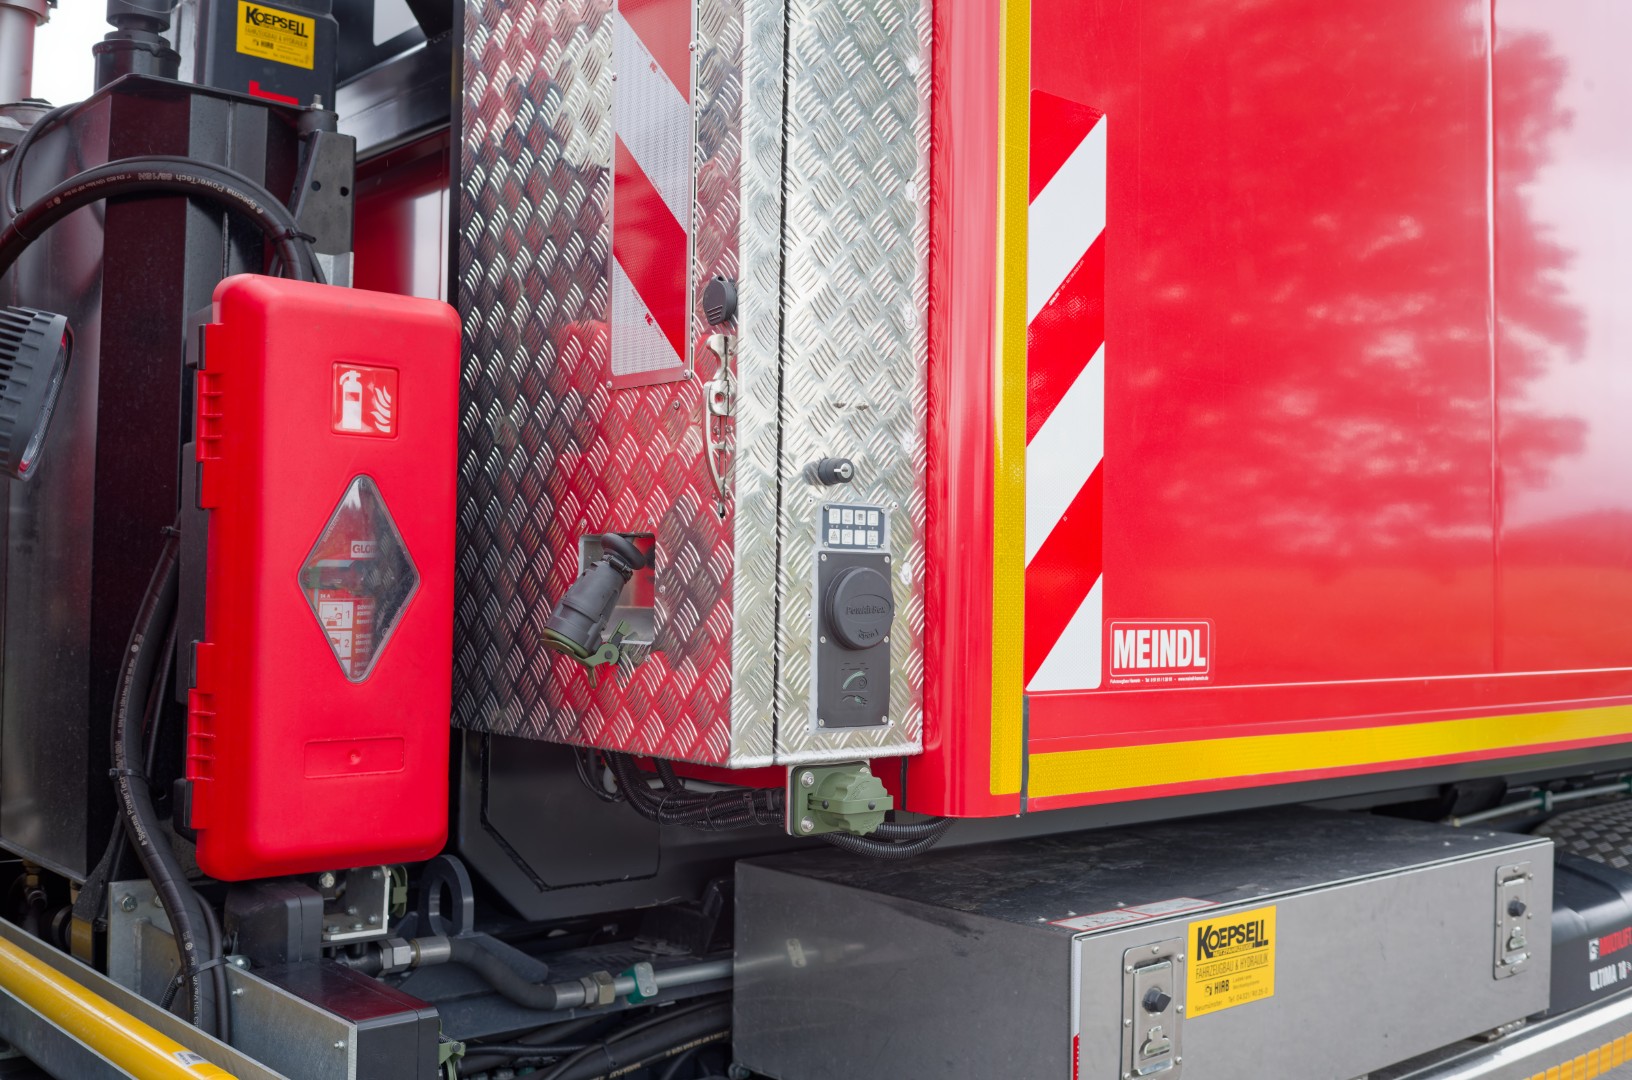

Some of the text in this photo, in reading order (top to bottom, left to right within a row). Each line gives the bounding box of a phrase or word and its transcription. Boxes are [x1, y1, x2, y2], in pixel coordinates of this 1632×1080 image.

[246, 5, 309, 38] KOEPSELL
[176, 174, 225, 193] PowerTech
[226, 188, 257, 210] Specma
[352, 544, 377, 554] GLOR
[345, 610, 350, 619] 1
[344, 639, 350, 648] 2
[1114, 629, 1206, 668] MEINDL
[131, 815, 146, 841] Specma
[1197, 920, 1268, 960] KOEPSELL
[1196, 962, 1234, 980] FAHRZEUGBAU
[1240, 953, 1268, 969] HYDRAULIK
[1590, 964, 1617, 991] ULTIMA
